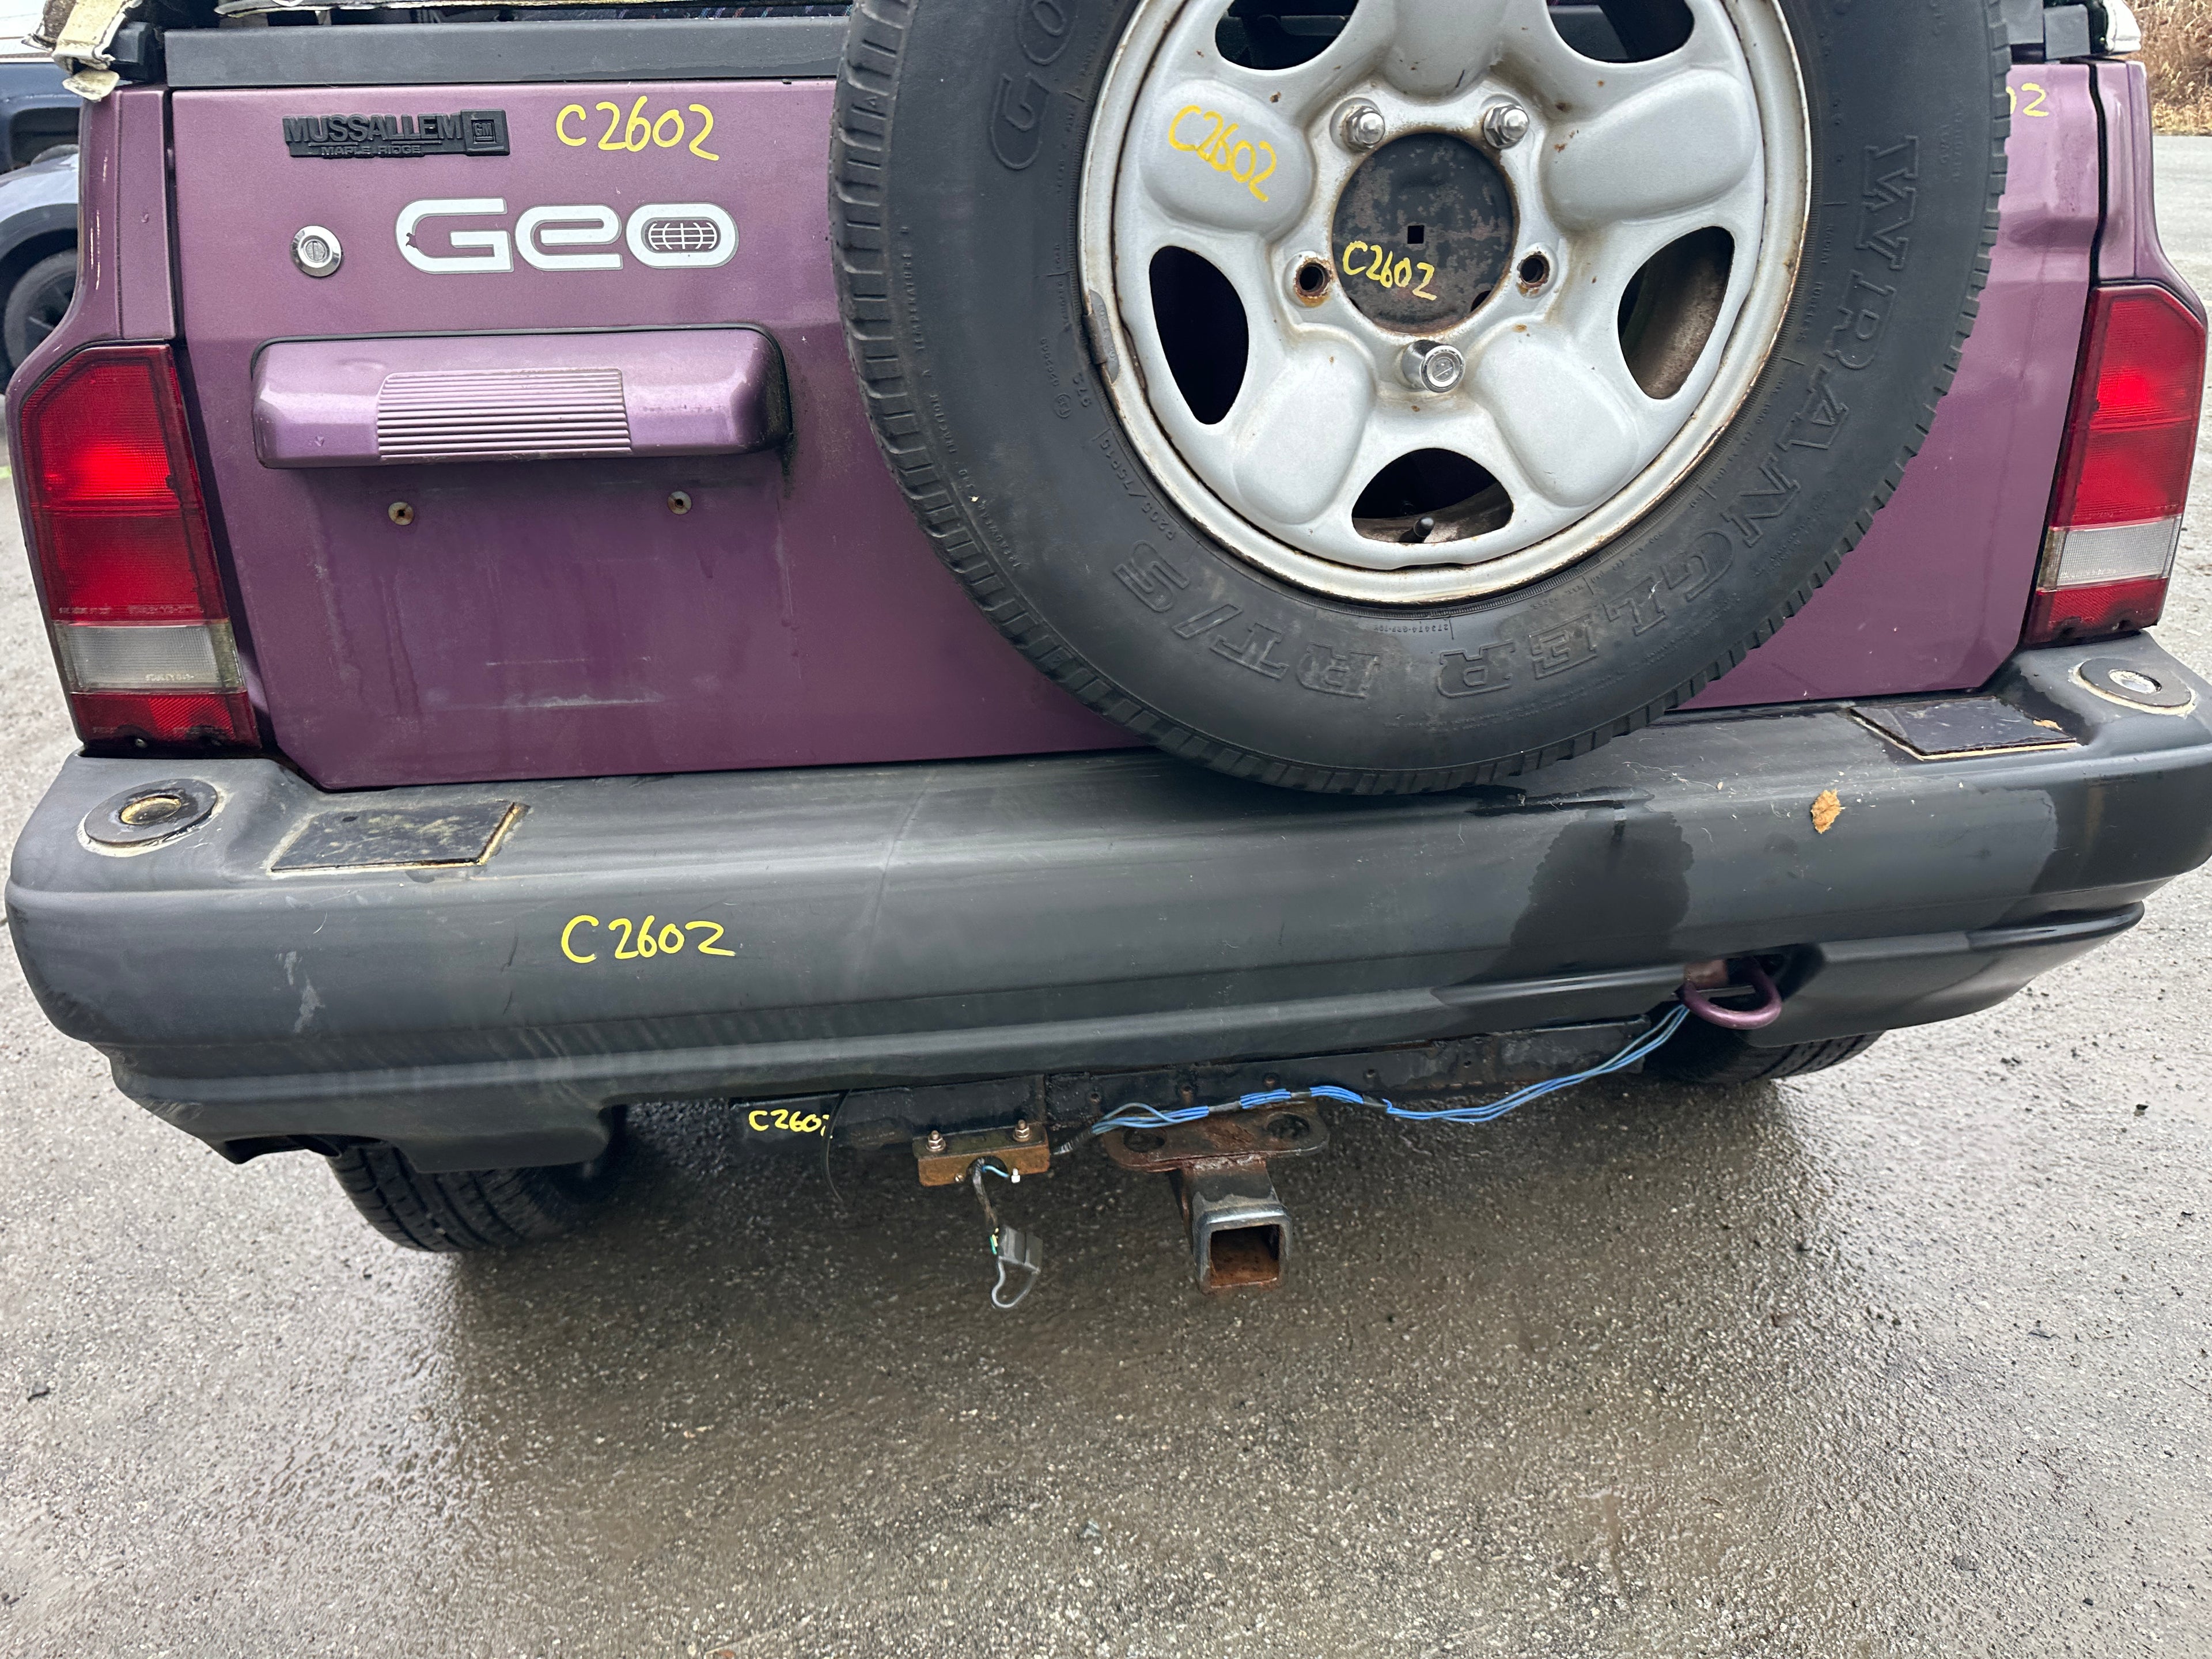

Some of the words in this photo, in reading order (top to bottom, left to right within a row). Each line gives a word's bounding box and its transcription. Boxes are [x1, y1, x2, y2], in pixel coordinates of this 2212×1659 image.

[283, 113, 463, 142] MUSSALLEM
[321, 146, 370, 155] MAPLE
[377, 145, 421, 154] RIDGE
[475, 123, 492, 137] GM
[555, 95, 719, 161] C2602
[1168, 105, 1277, 202] C2602
[1342, 240, 1437, 301] C2602
[561, 915, 736, 963] C2602
